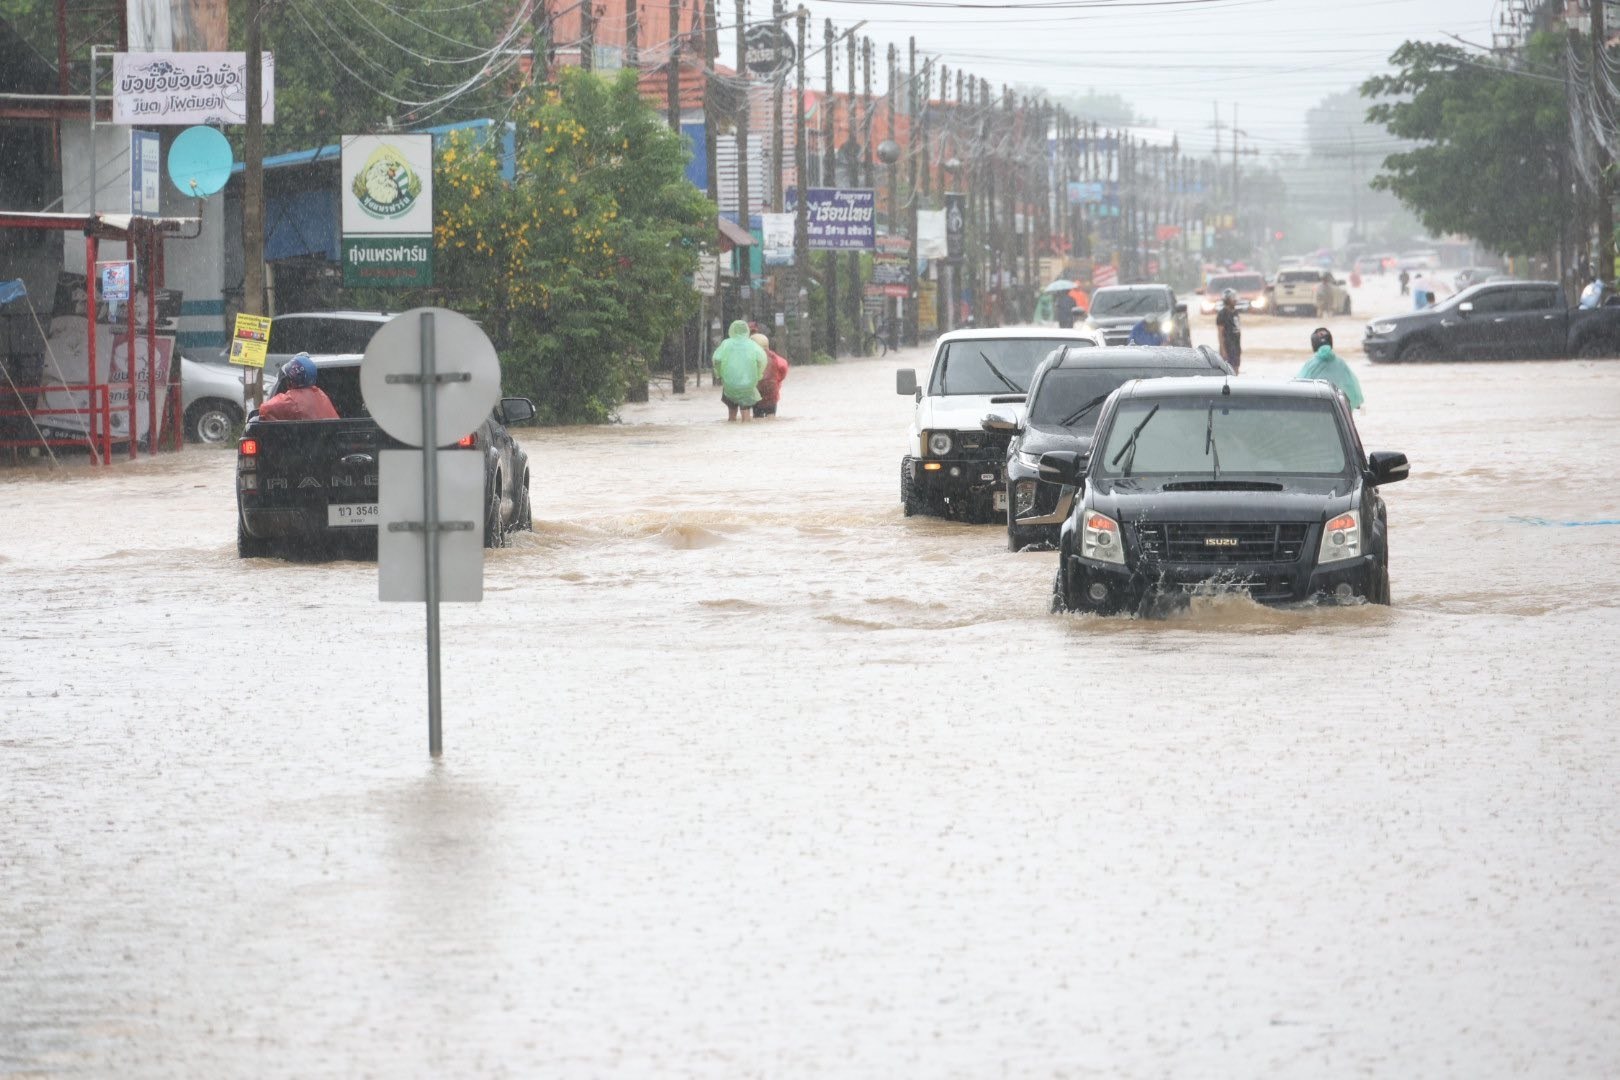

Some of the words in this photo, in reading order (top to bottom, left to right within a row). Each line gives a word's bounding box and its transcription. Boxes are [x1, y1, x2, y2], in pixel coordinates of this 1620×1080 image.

[816, 200, 873, 221] เรือนไทย
[349, 244, 427, 265] ทุ่งแพรฟาร์ม
[356, 506, 379, 515] 3546
